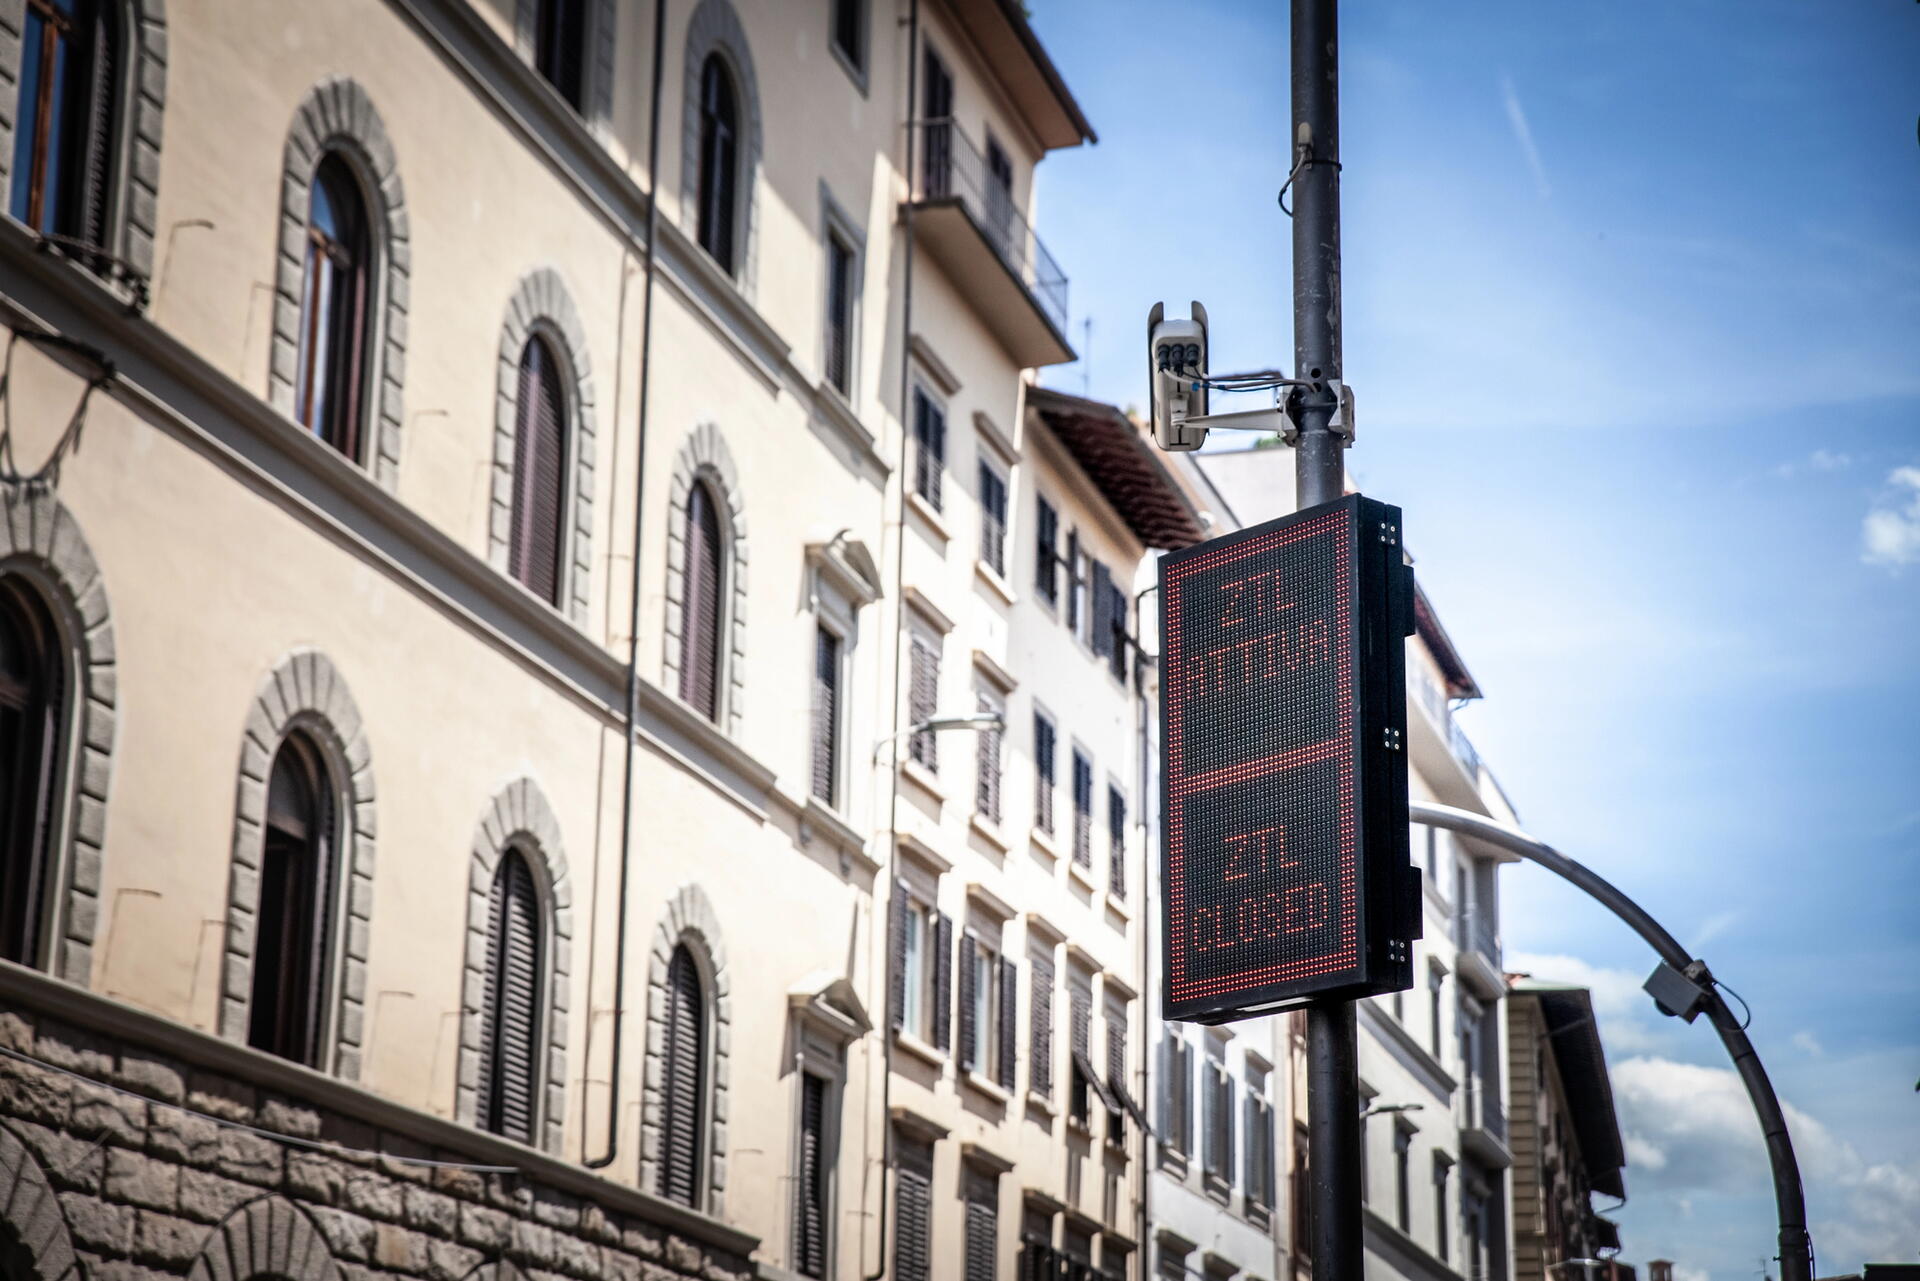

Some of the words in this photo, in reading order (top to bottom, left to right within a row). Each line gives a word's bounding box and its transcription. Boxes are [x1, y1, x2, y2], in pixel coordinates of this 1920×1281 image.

[1220, 569, 1295, 626] ZTL
[1185, 619, 1328, 699] ATTIVA
[1223, 825, 1299, 881] ZTL
[1193, 882, 1328, 951] CLOSED
